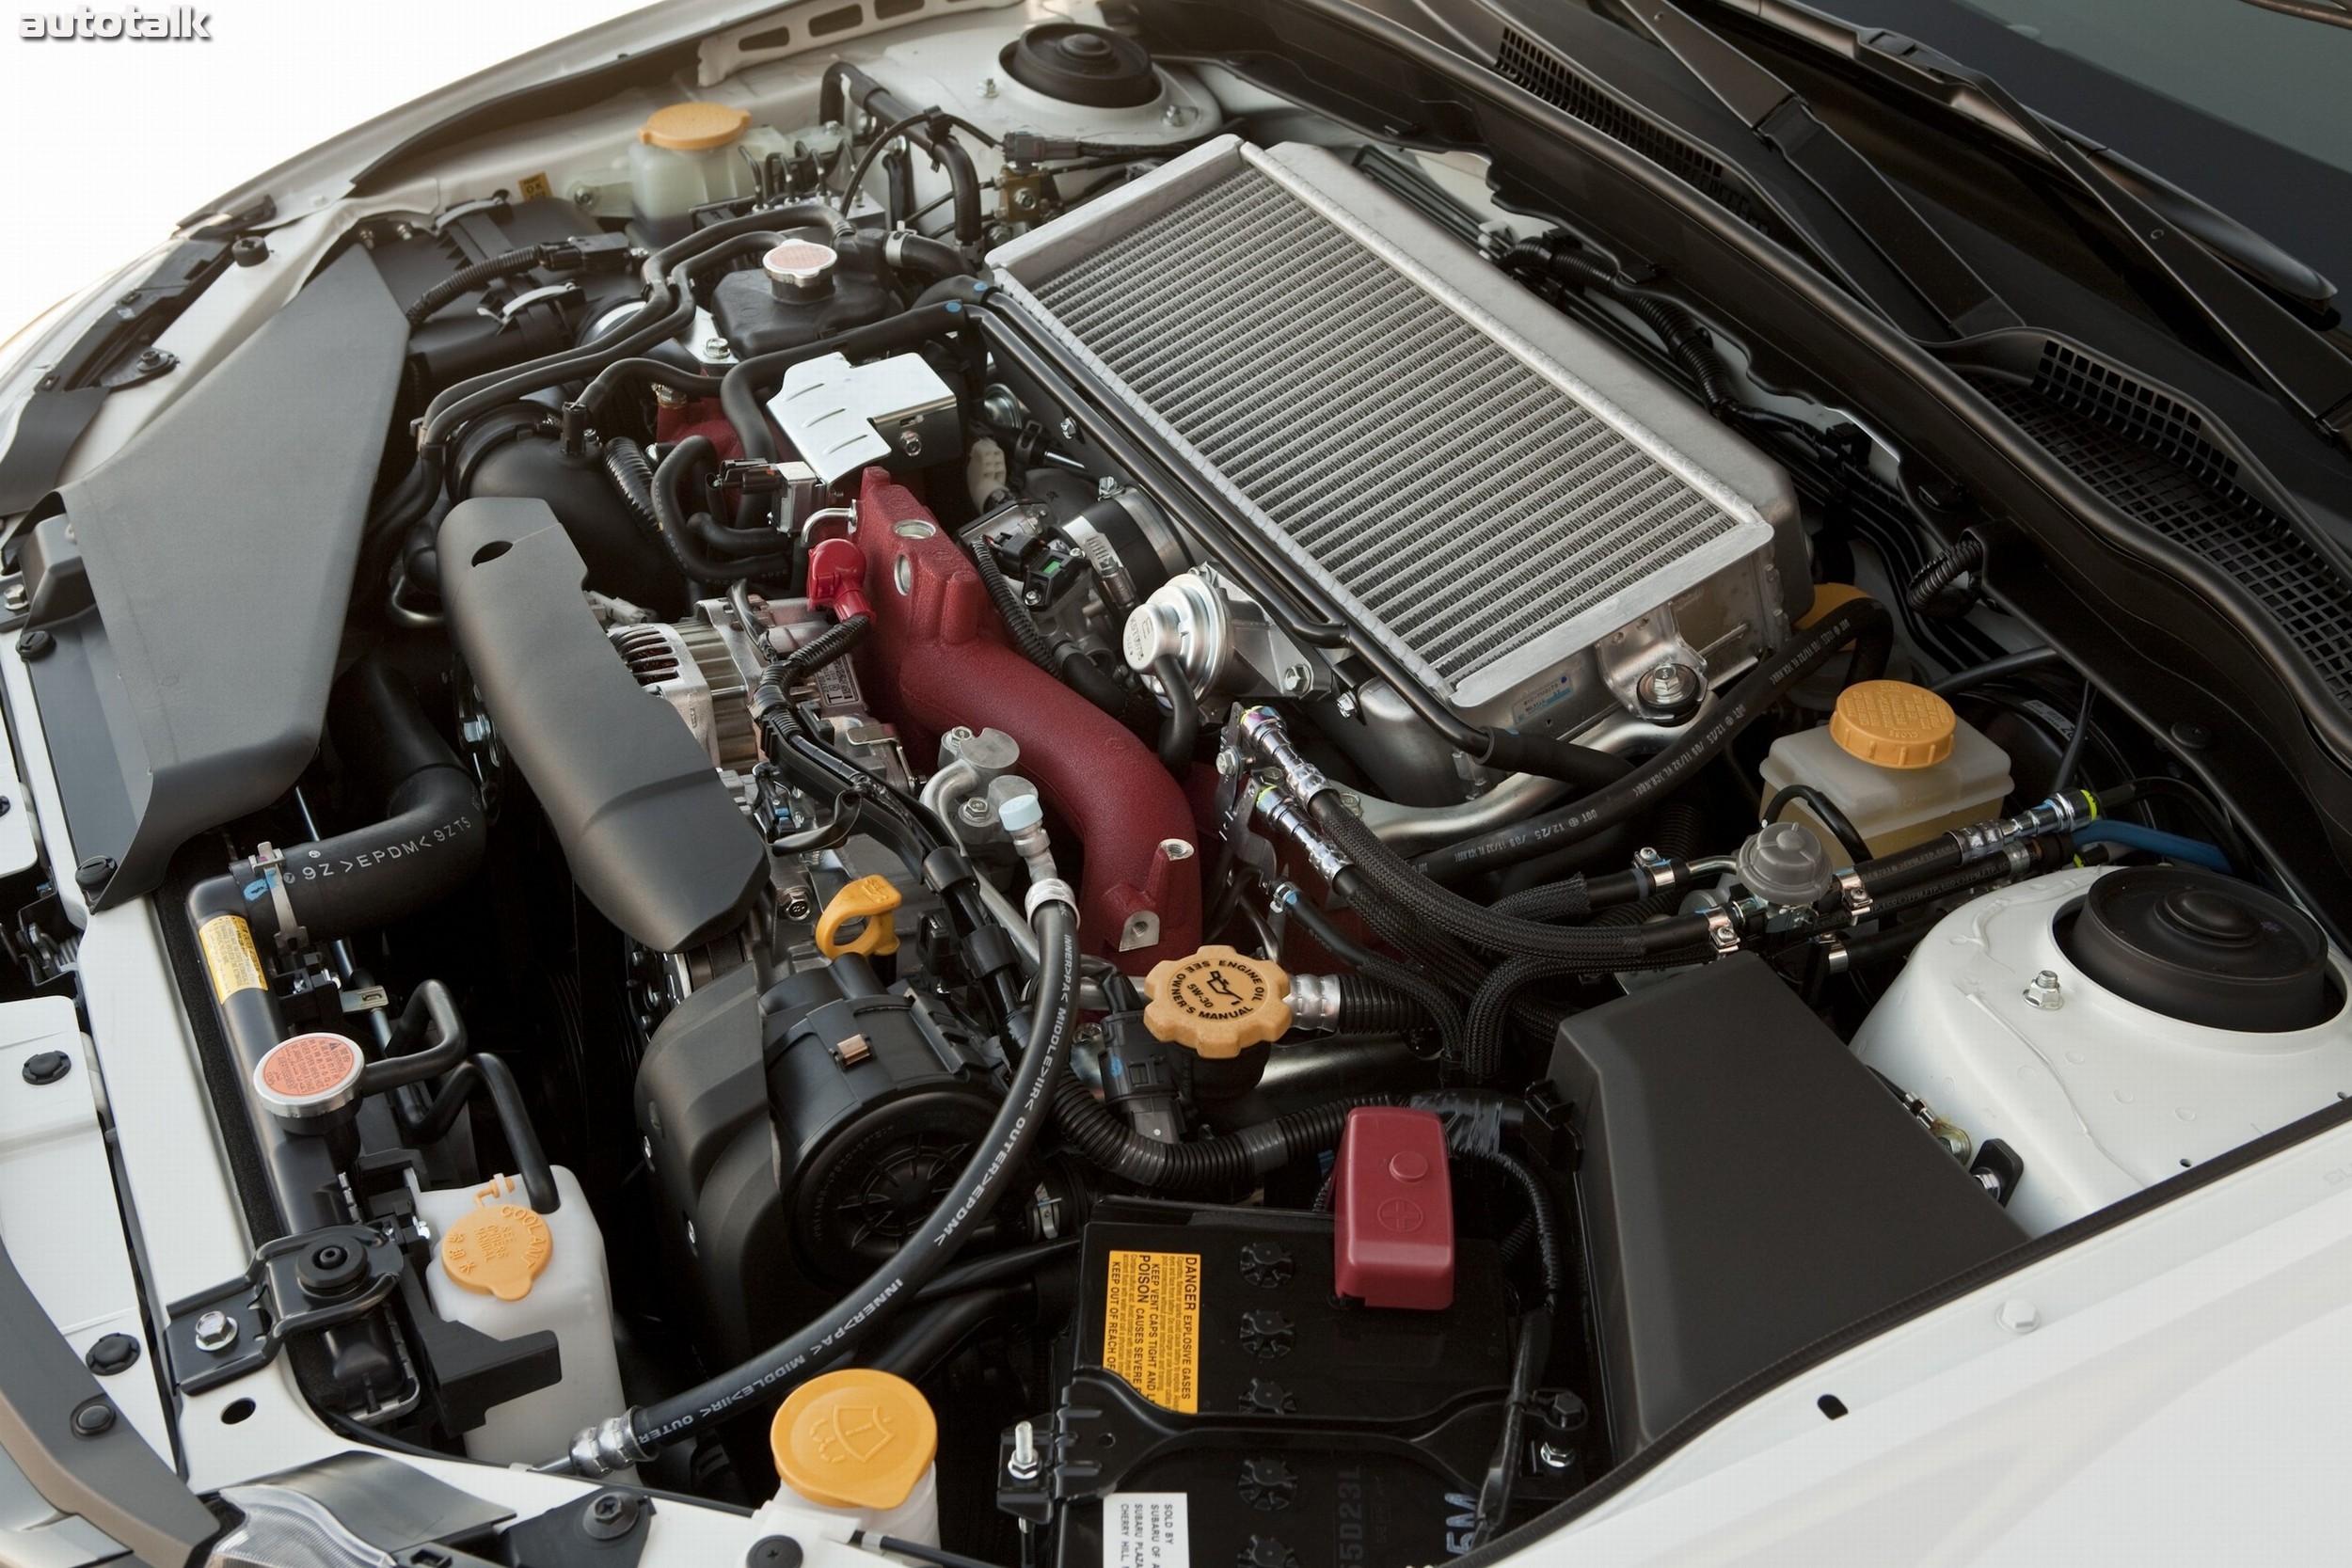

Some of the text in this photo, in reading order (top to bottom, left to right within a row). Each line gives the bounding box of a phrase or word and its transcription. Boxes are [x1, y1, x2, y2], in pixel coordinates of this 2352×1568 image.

[1534, 822, 1565, 840] 12/25
[1581, 808, 1598, 823] DOT
[302, 863, 334, 880] 9Z
[1171, 960, 1253, 1020] SEE OWNER'S MANUAL
[1187, 983, 1214, 1007] 5W-30
[1218, 960, 1264, 1002] ENGINE OIL
[501, 1204, 547, 1269] COOLANT
[1137, 1255, 1150, 1303] POISON
[1151, 1263, 1160, 1286] KEEP
[1150, 1289, 1159, 1310] VENT
[809, 1276, 903, 1355] INNER>PA<
[1106, 1261, 1120, 1370] KEEP OUT OF REACH OF
[1135, 1308, 1145, 1343] CAUSES
[1149, 1314, 1158, 1338] CAPS
[1182, 1257, 1197, 1400] DANGER EXPLOSIVE GASES
[1133, 1348, 1143, 1384] SEVERE
[1148, 1341, 1157, 1368] TIGHT
[698, 1354, 805, 1419] MIDDLE>IIR<
[1147, 1371, 1155, 1391] AND
[1151, 1504, 1159, 1542] SUBARU
[1166, 1532, 1173, 1544] BY
[1152, 1546, 1160, 1558] OF
